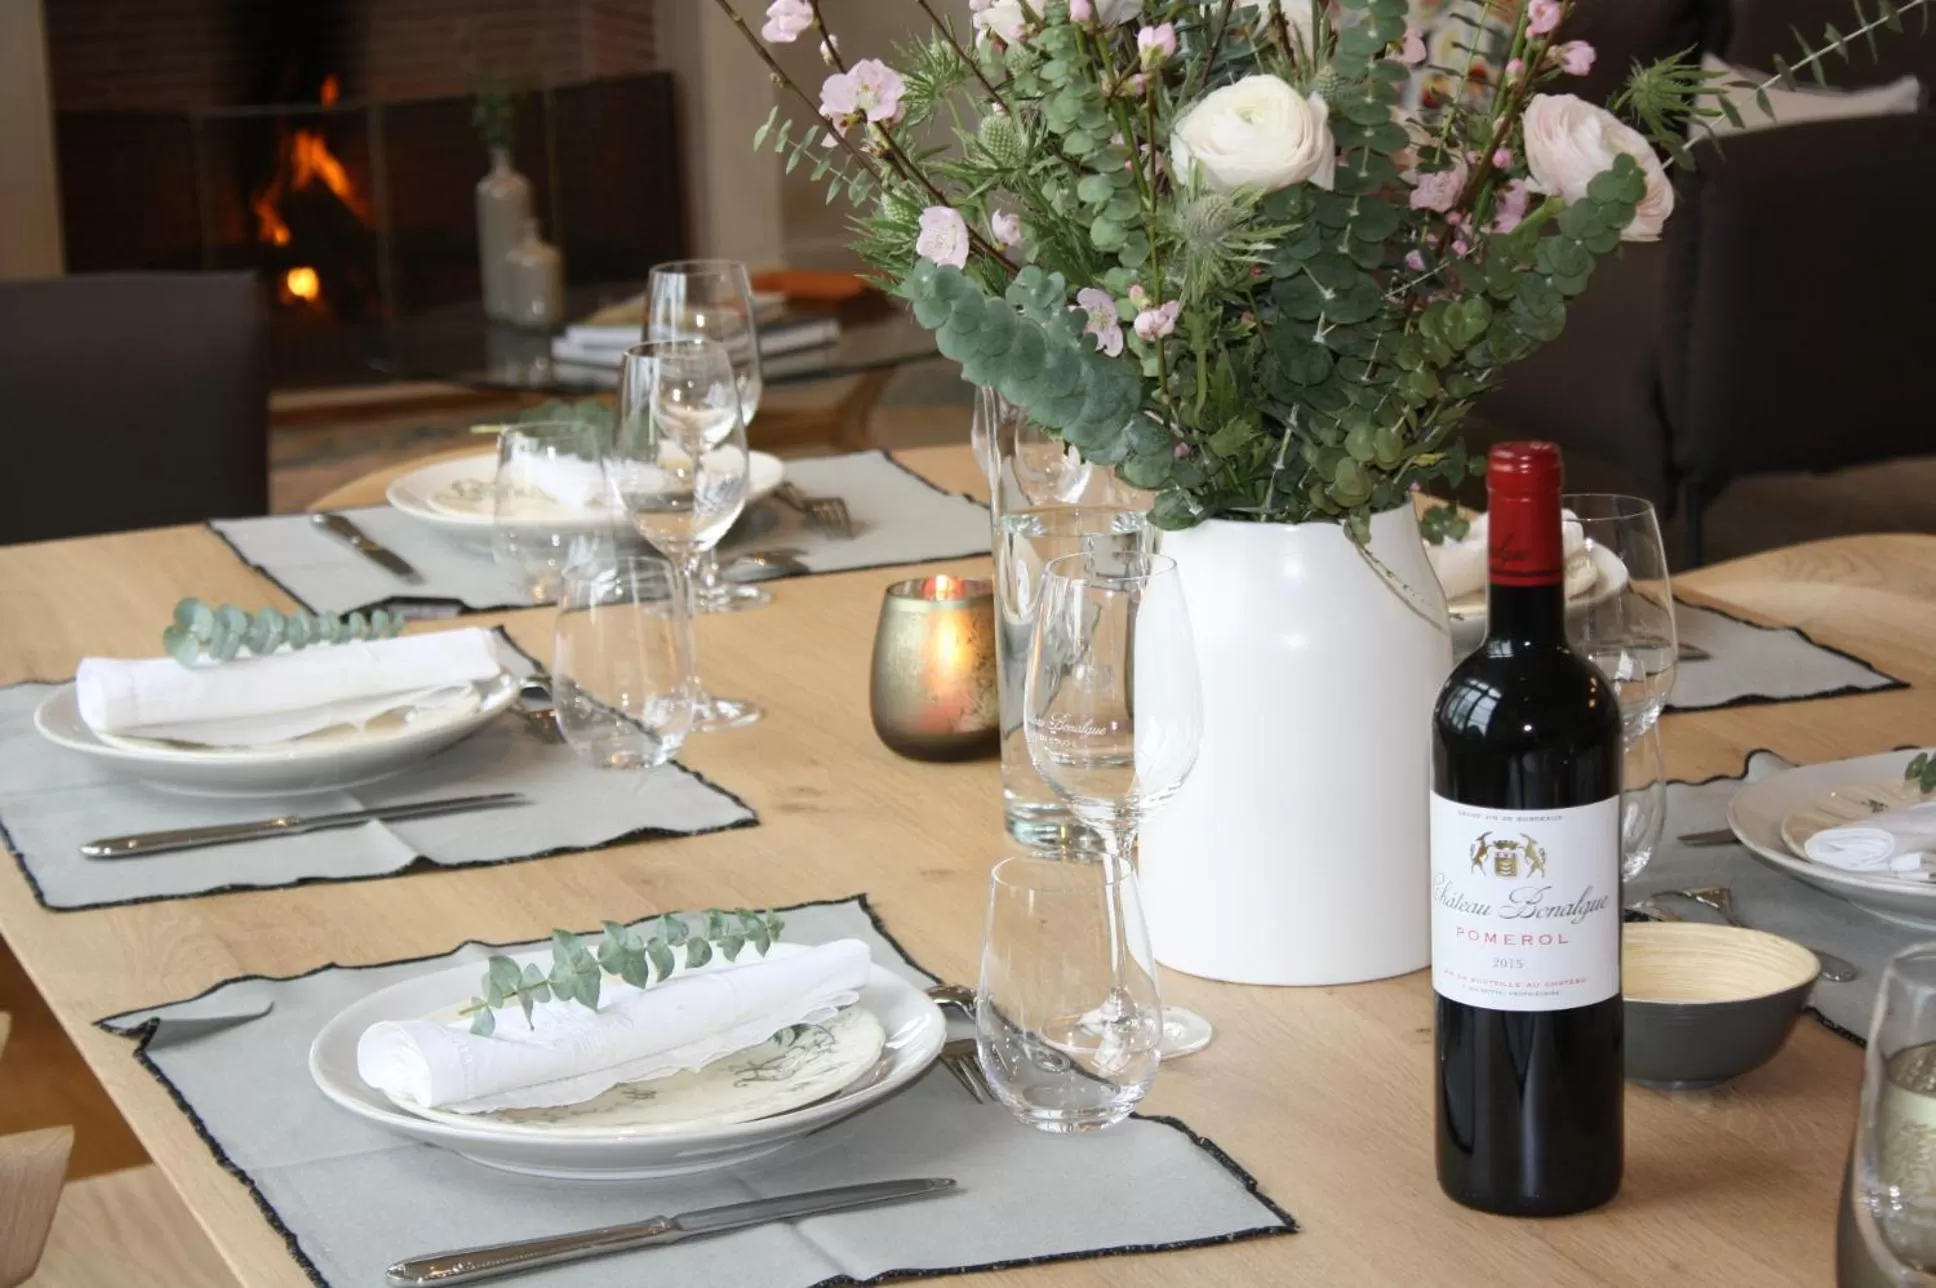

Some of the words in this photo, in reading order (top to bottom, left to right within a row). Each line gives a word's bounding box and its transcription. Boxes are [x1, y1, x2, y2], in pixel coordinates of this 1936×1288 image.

[1499, 884, 1609, 925] Bonalgue
[1456, 926, 1569, 946] POMEROL
[1492, 957, 1524, 969] 2015
